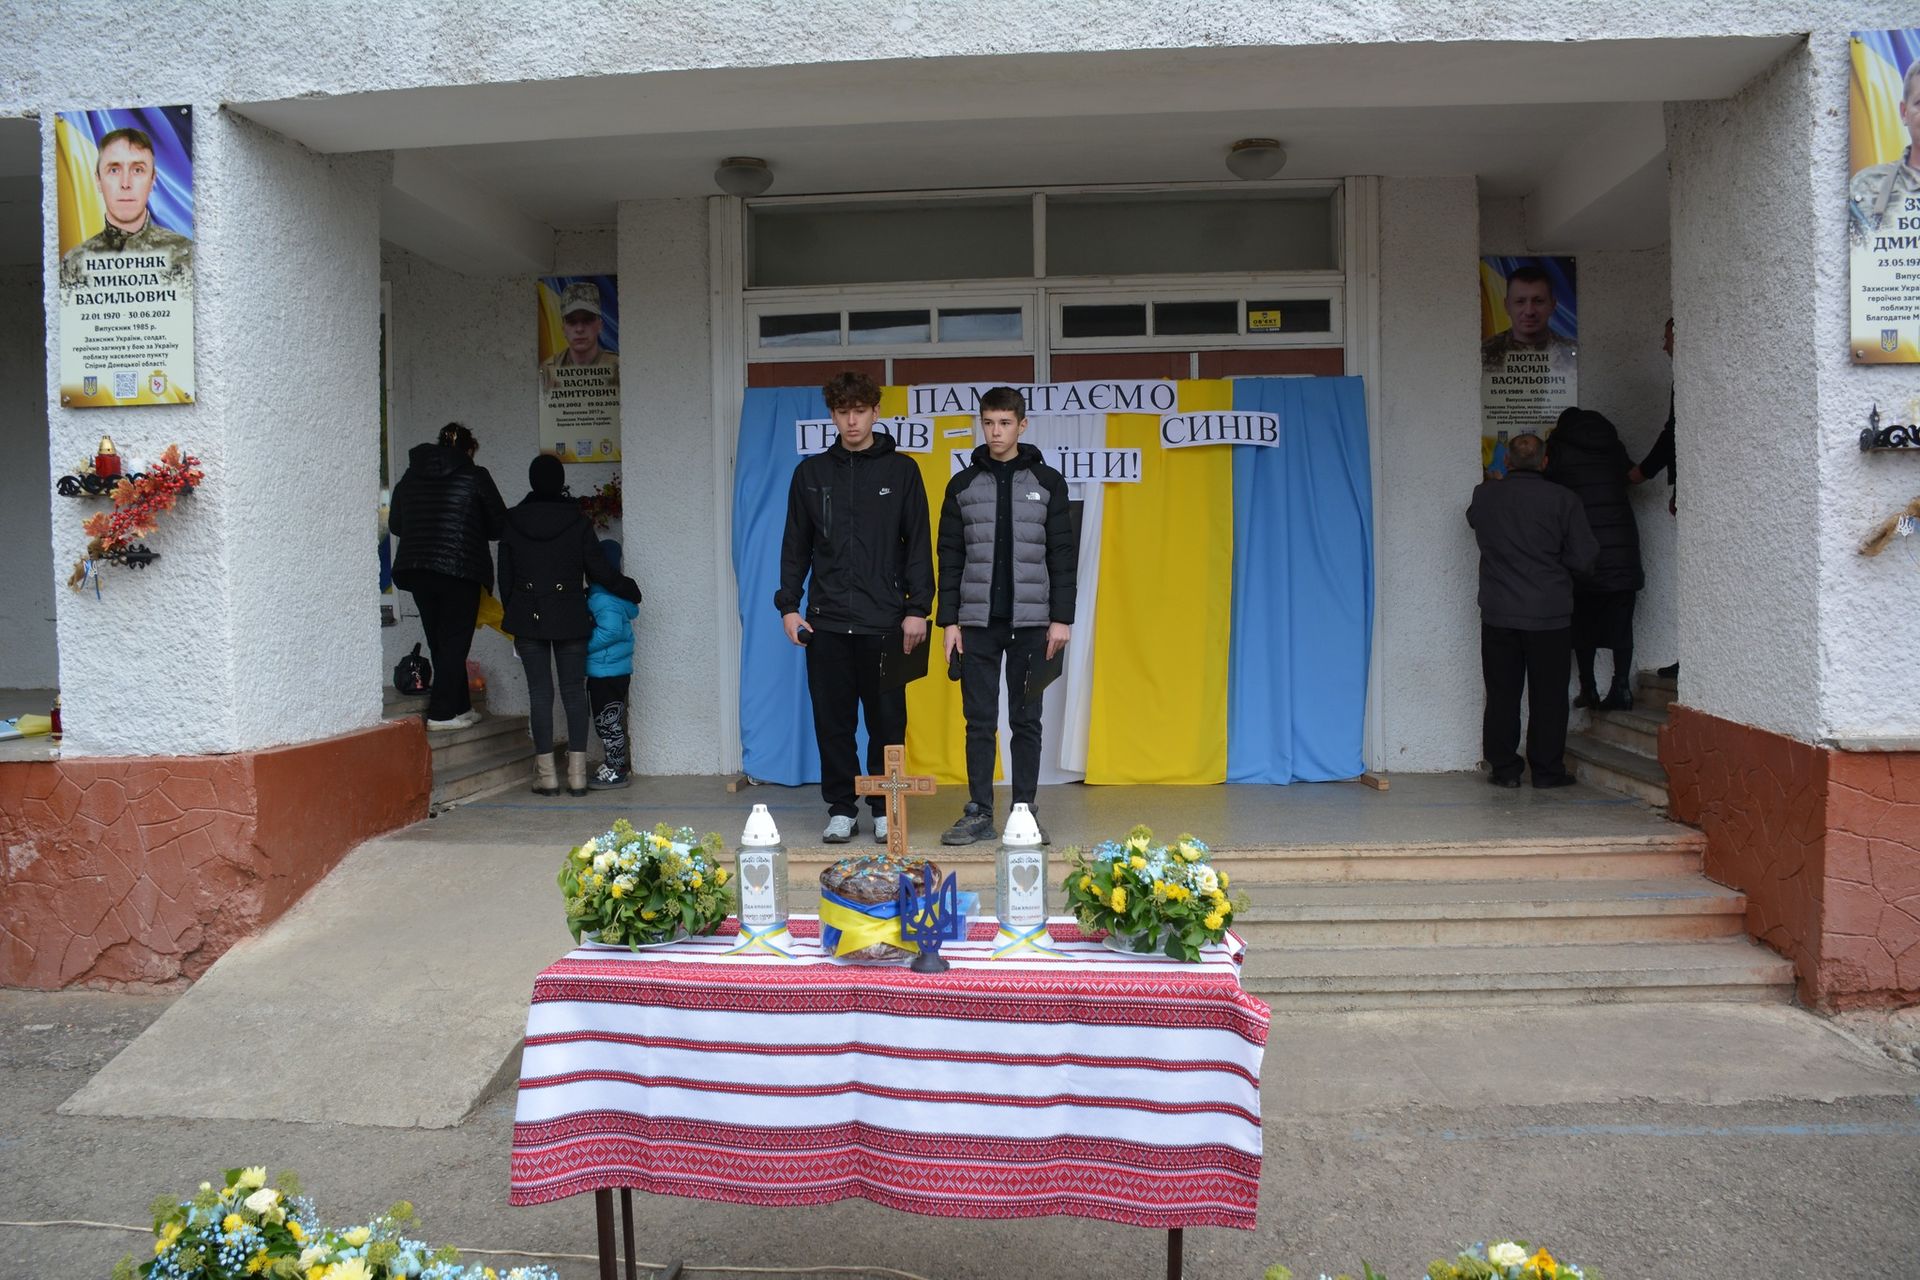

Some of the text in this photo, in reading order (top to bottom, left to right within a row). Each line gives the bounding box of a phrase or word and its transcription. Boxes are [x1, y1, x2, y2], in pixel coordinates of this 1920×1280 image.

[1873, 236, 1920, 252] ДМИ
[86, 256, 166, 271] НАГОРНЯК
[93, 274, 160, 288] МИКОЛА
[1901, 284, 1920, 292] Укра
[76, 290, 177, 306] ВАСИЛЬОВИЧ
[1868, 294, 1901, 303] героїчно
[1880, 304, 1912, 312] поблизу
[128, 310, 170, 319] 30.06.2022
[94, 325, 131, 333] Випускник
[1507, 353, 1549, 362] ЛЮТАН
[556, 367, 612, 377] НАГОРНЯК
[1507, 365, 1551, 374] ВАСИЛЬ
[563, 379, 604, 387] ВАСИЛЬ
[1491, 376, 1566, 385] ВАСИЛЬОВИЧ
[550, 389, 616, 400] ДМИТРОВИЧ
[913, 384, 1175, 415] ПАЯТАЄМО
[798, 416, 929, 450] ГЕЇВ
[1162, 414, 1278, 444] СИНІВ
